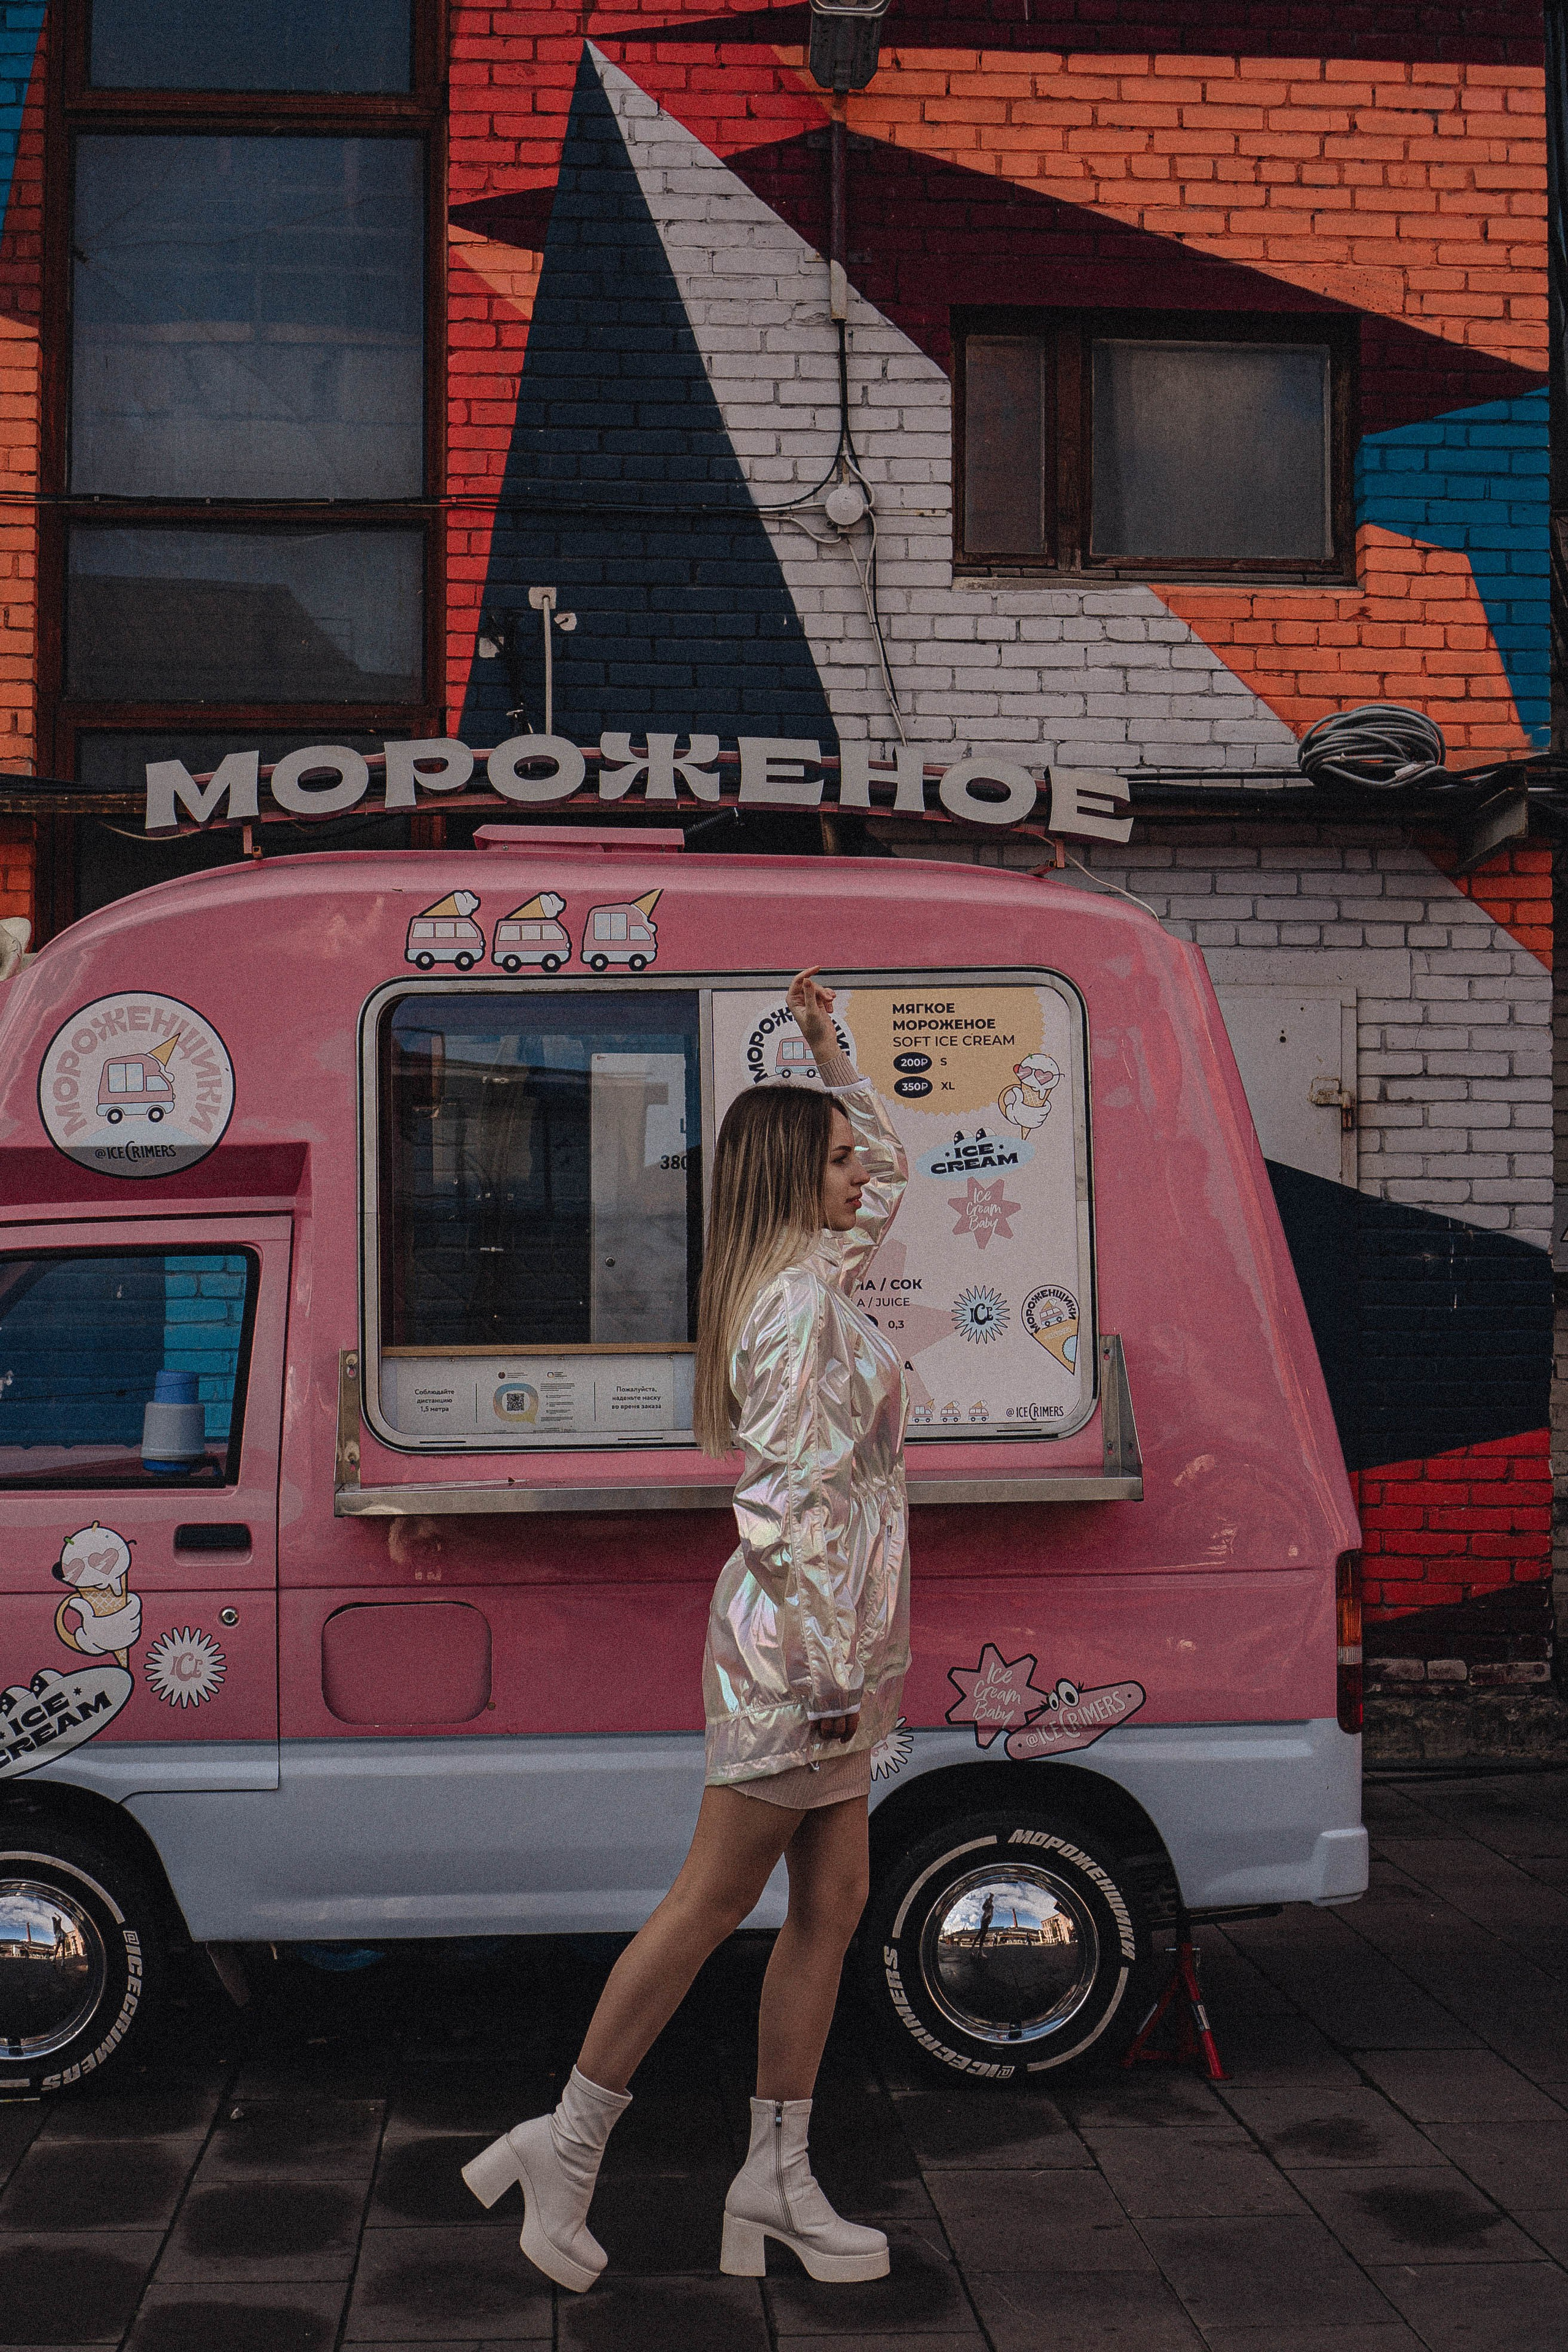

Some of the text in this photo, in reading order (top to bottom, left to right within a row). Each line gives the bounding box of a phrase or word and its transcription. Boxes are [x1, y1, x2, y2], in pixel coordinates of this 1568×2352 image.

[145, 731, 1134, 843] МОРОЖЕНОЕ
[892, 1003, 955, 1014] МЯГКОЕ
[892, 1019, 996, 1031] МОРОЖЕНОЕ
[893, 1035, 1015, 1047] SOFT ICE CREAM
[53, 1006, 222, 1137] МОРОЖЕНЩИКИ
[941, 1082, 955, 1090] XL
[95, 1140, 176, 1162] @ICECRIMERS
[954, 1143, 994, 1158] ICE
[930, 1152, 1019, 1174] CREAM
[973, 1188, 991, 1204] Ice
[966, 1201, 1002, 1216] Cream
[968, 1215, 999, 1234] Baby
[890, 1278, 922, 1290] СОК
[875, 1297, 910, 1307] JUICE
[1025, 1289, 1077, 1334] МОРОЖЕНЩИКИ
[888, 1320, 905, 1330] 0,3
[970, 1303, 993, 1325] ICE
[1006, 1403, 1064, 1420] @ICECRIMERS
[170, 1652, 204, 1681] ICE
[987, 1662, 1014, 1684] Ice
[973, 1679, 1022, 1705] Cream
[8, 1692, 70, 1737] ICE
[973, 1699, 1015, 1728] Baby
[1026, 1691, 1126, 1747] @ICECRIMERS
[1008, 1829, 1135, 1961] МОРОЖЕНЩИКИ
